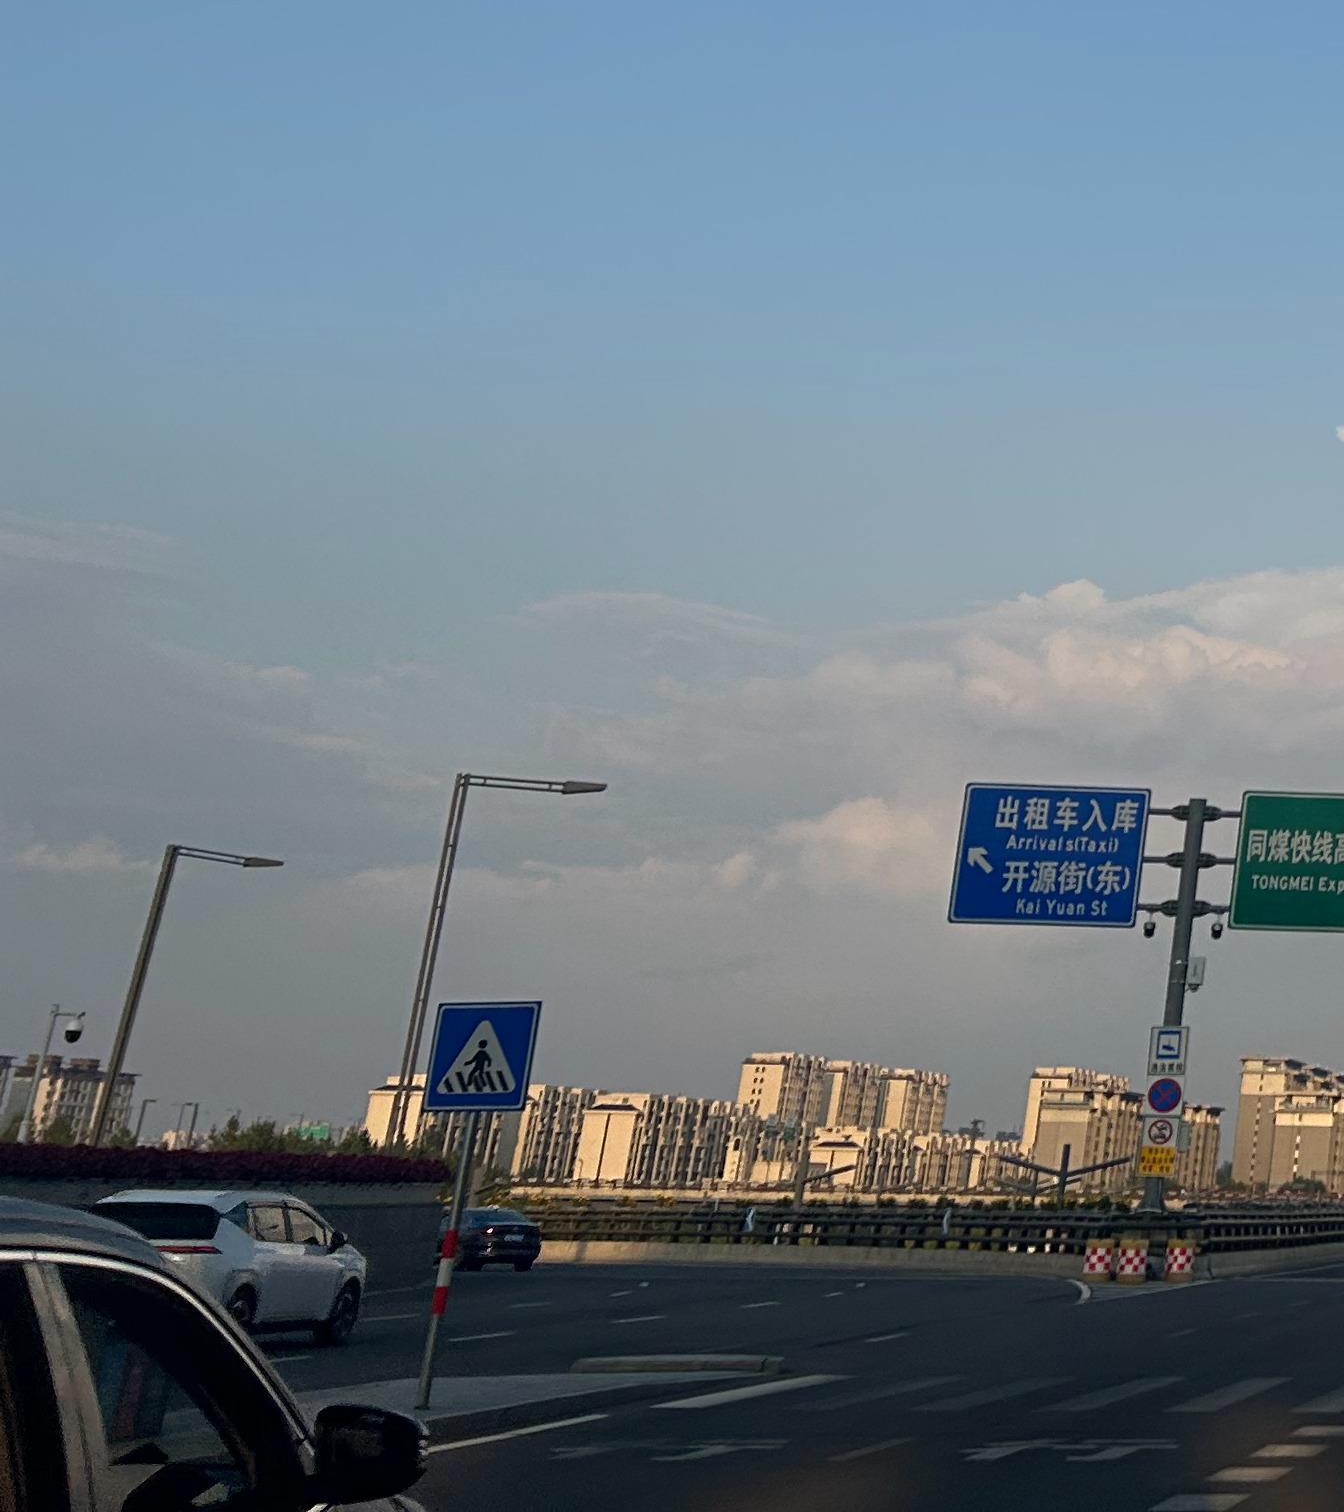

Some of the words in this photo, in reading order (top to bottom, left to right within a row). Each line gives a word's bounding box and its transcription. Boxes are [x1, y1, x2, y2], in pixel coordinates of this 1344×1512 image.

[994, 795, 1139, 833] 出租车入库
[1252, 874, 1313, 892] TONGMEI
[1016, 898, 1041, 914] Kai
[1046, 899, 1085, 916] Yuan
[1091, 900, 1108, 917] St
